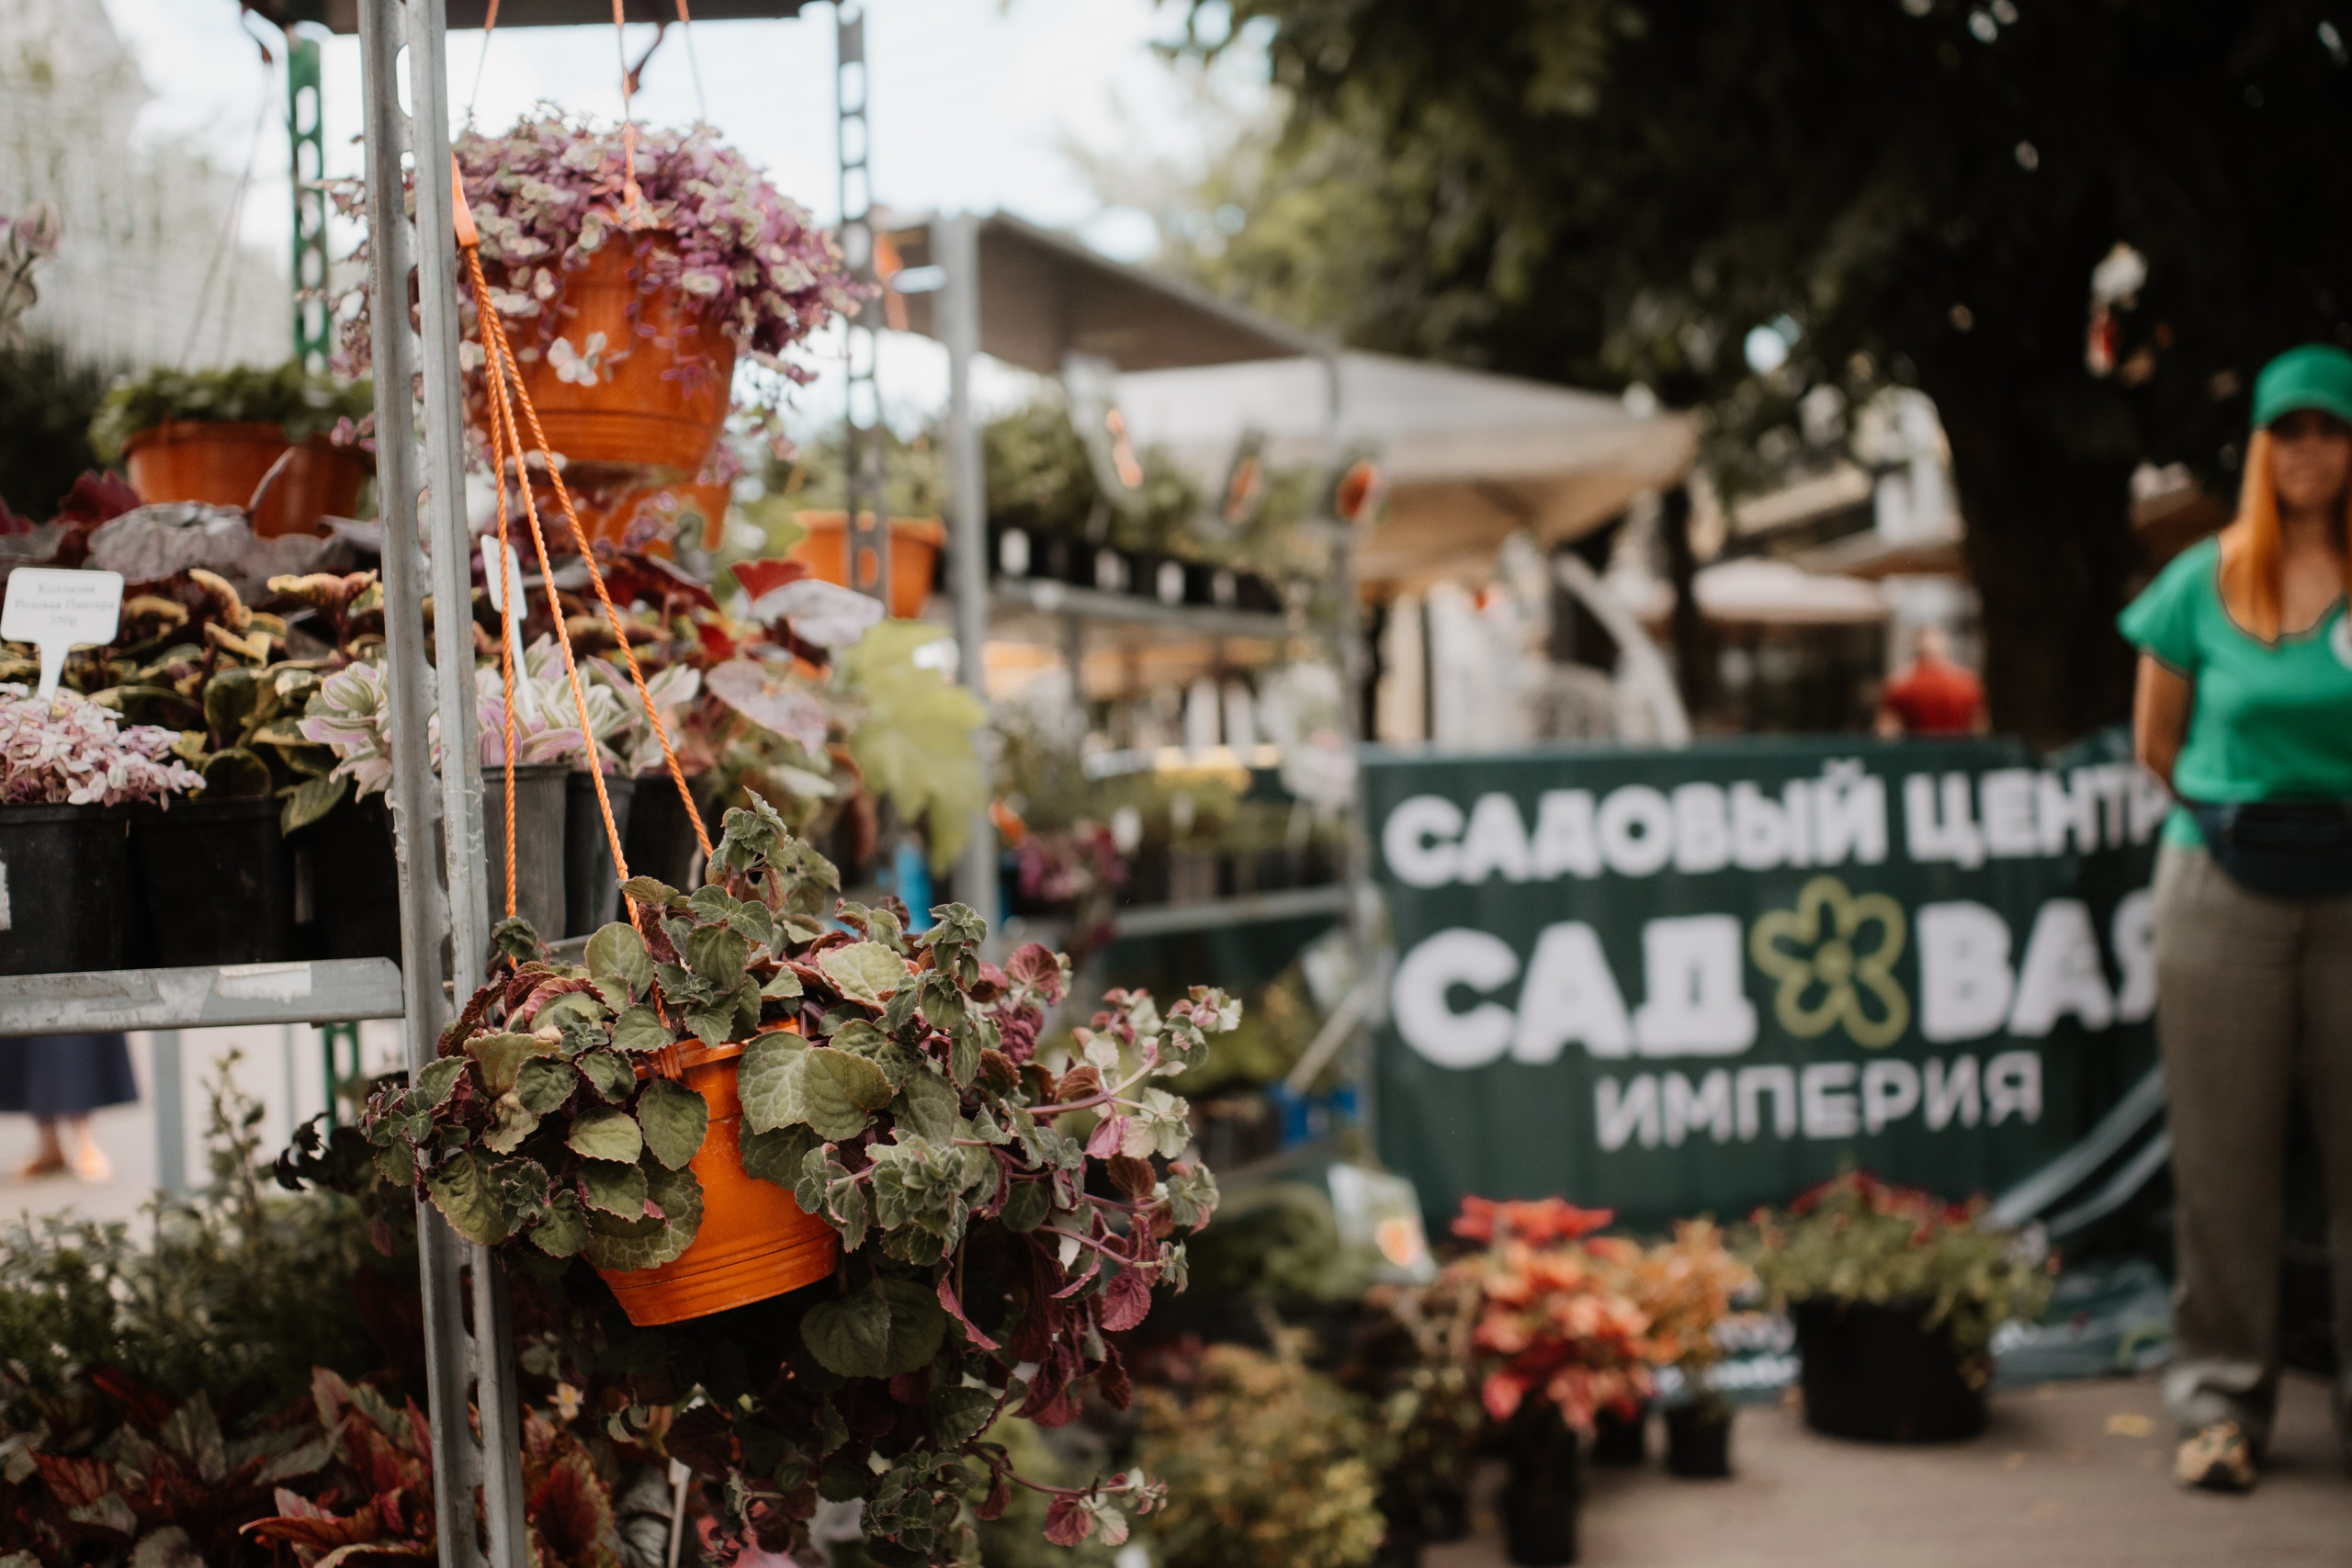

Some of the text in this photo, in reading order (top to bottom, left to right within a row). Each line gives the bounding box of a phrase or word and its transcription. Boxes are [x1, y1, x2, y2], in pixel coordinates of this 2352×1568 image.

[1383, 759, 2169, 888] САДОВЫЙ ЦЕНТР
[1594, 1051, 2043, 1152] ИМПЕРИЯ
